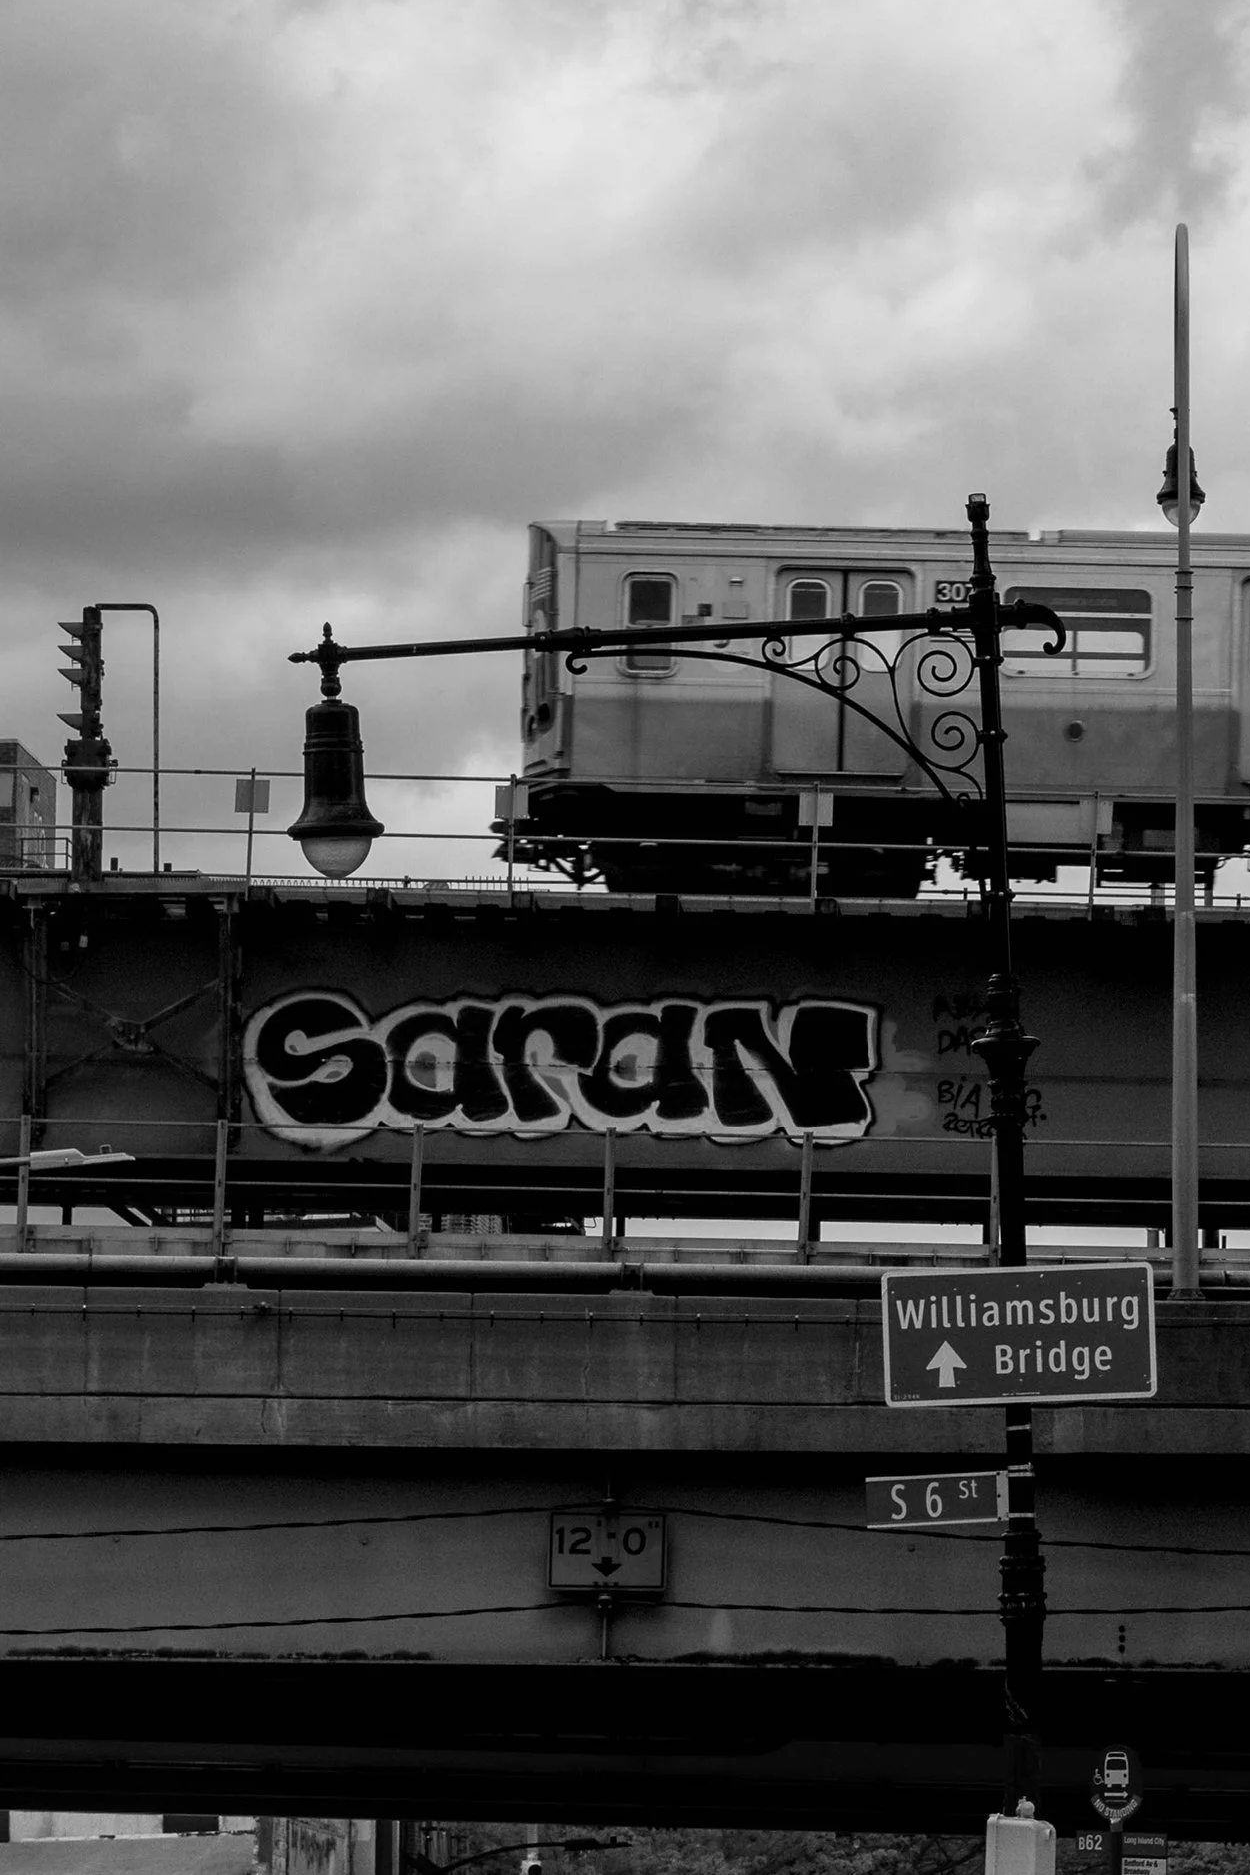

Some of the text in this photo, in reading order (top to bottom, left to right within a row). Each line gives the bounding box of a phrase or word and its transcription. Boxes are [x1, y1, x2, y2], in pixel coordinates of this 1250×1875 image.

[896, 1290, 1140, 1330] Williamsburg
[995, 1340, 1113, 1380] Bridge
[890, 1479, 978, 1521] S 6 St
[1093, 1798, 1138, 1818] NO STANDING
[1078, 1834, 1103, 1851] B62
[1124, 1836, 1137, 1846] Long
[1154, 1836, 1165, 1846] City
